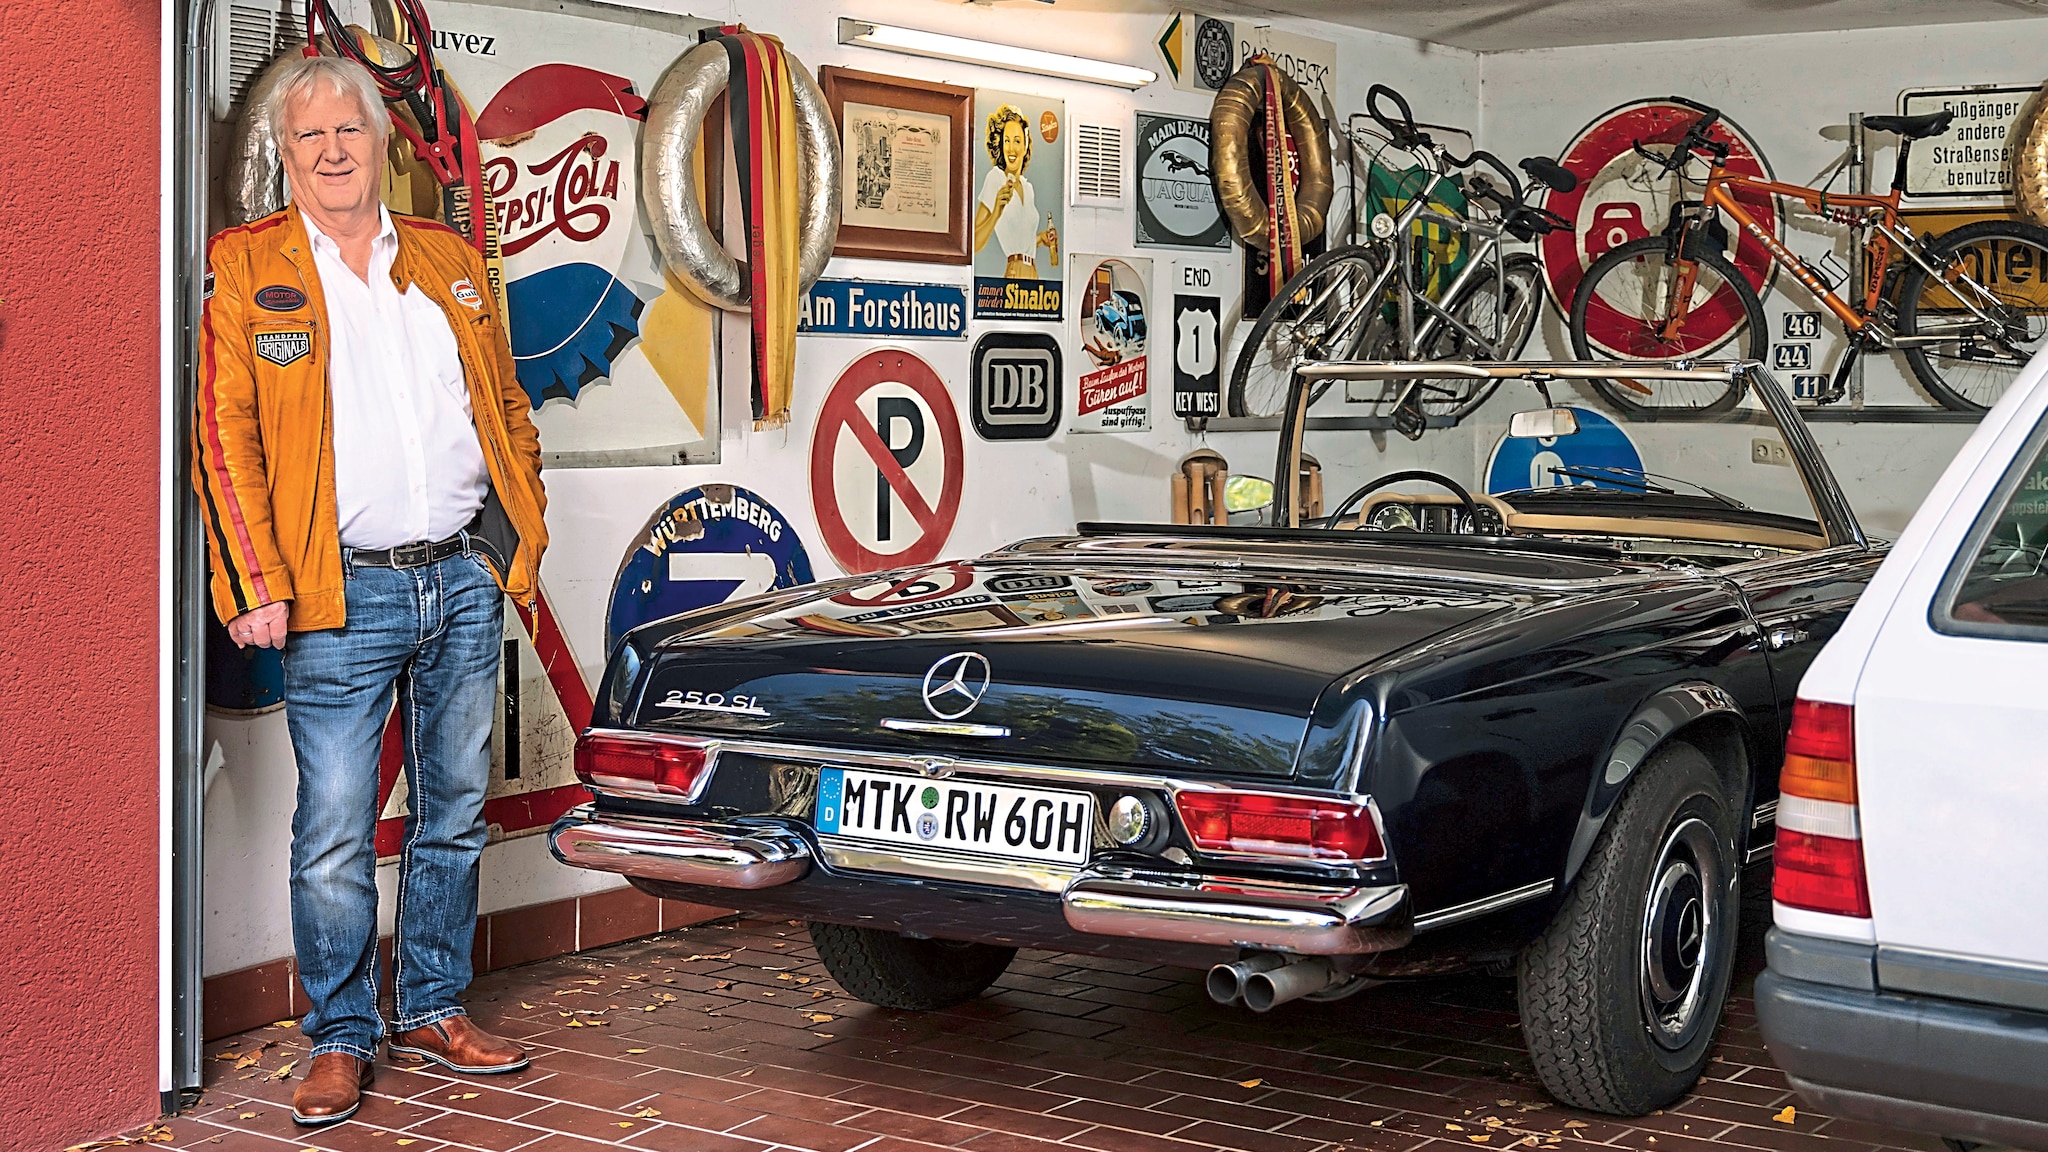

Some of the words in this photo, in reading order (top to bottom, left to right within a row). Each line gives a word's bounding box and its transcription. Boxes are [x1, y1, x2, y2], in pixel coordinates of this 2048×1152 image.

[1148, 121, 1176, 150] MAIN
[1178, 120, 1210, 145] DEALE
[1957, 123, 2005, 141] andere
[1144, 179, 1214, 203] JAGUA
[1184, 267, 1211, 287] END
[265, 291, 297, 299] MOTOR
[1004, 283, 1060, 311] Sinalco
[798, 292, 836, 327] Am
[848, 288, 961, 331] Forsthaus
[1789, 315, 1814, 335] 46
[260, 340, 306, 361] ORIGINALS
[1192, 325, 1200, 363] 1
[1779, 346, 1805, 367] 44
[990, 364, 1044, 408] DB
[1083, 386, 1117, 408] Türen
[1118, 371, 1143, 396] auf!
[1800, 377, 1819, 397] 11
[1176, 391, 1193, 412] KEY
[1196, 391, 1218, 412] WEST
[1101, 416, 1119, 427] sind
[1121, 415, 1146, 428] giftig!
[877, 397, 925, 541] P
[666, 690, 725, 707] 250
[731, 695, 764, 711] SL
[824, 806, 835, 822] D
[843, 778, 916, 833] MTK
[945, 789, 997, 843] RW
[1004, 796, 1085, 854] 60H
